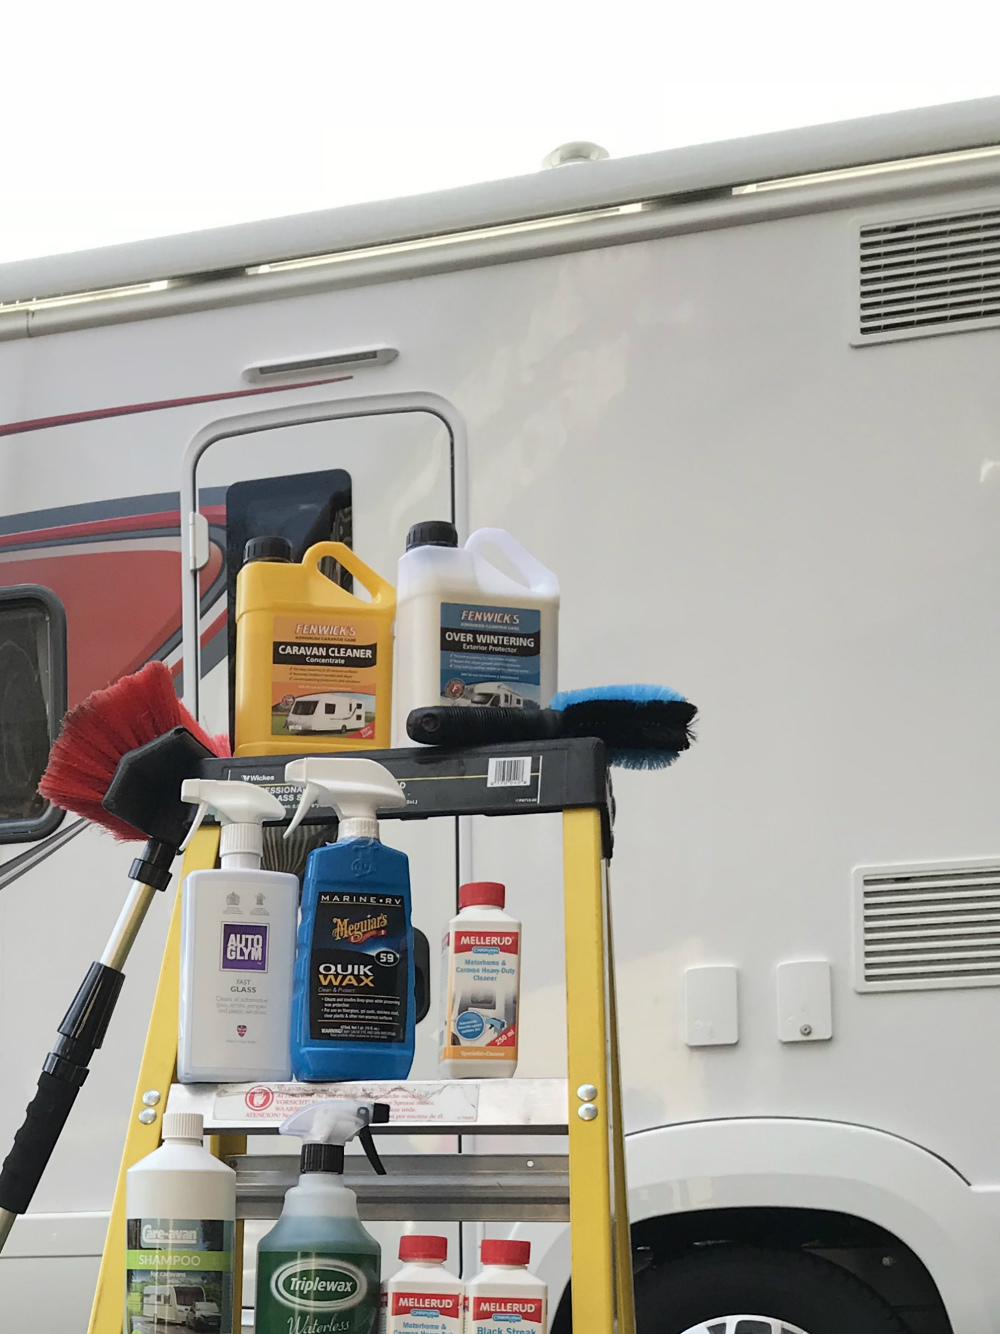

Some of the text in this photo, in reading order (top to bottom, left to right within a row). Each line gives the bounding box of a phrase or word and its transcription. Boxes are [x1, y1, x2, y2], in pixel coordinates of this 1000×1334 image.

[461, 610, 520, 624] FENWICK'S
[294, 624, 356, 637] FENWICK'S
[445, 632, 534, 647] OVER WINTERING
[279, 645, 372, 658] CARAVAN CLEANER
[488, 645, 517, 653] Protector
[306, 656, 345, 664] Concentrate
[332, 912, 388, 942] Meguiar's
[227, 933, 262, 948] AUTO
[460, 936, 512, 945] MELLERUD
[226, 946, 262, 961] GLYM
[380, 953, 394, 962] 59
[318, 963, 373, 976] QUIK
[318, 974, 375, 987] WAX
[495, 1029, 515, 1046] 250 ml
[139, 1255, 201, 1266] SHAMPOO
[289, 1277, 353, 1294] Triplewax
[398, 1298, 453, 1308] MELLERUD
[480, 1302, 536, 1313] MELLERUD
